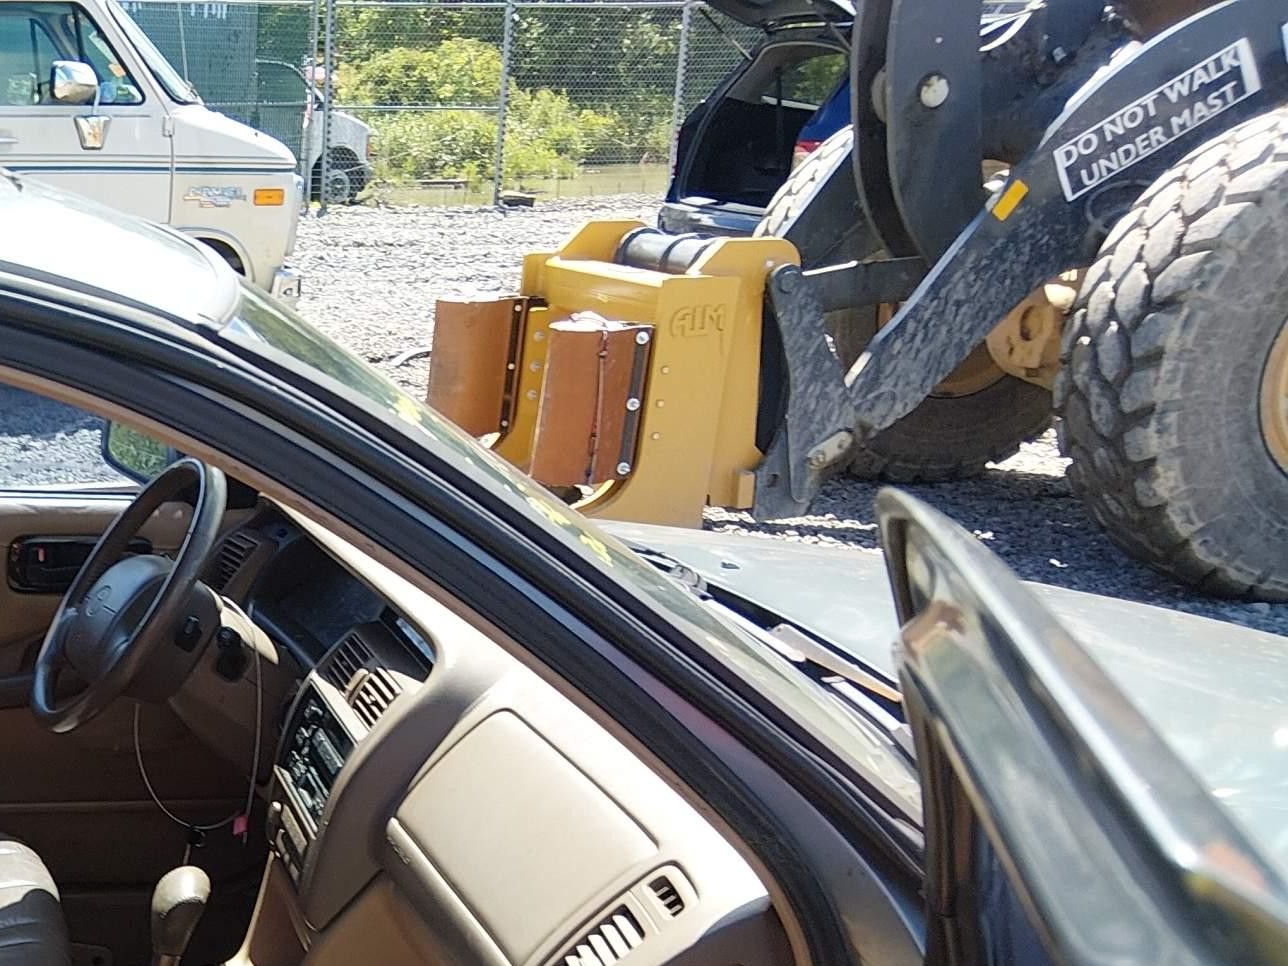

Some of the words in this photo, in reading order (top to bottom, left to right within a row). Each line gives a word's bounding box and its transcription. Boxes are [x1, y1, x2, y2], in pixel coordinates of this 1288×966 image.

[1062, 133, 1099, 169] DO
[1102, 94, 1159, 142] NOT
[1162, 45, 1242, 104] WALK
[1080, 125, 1168, 187] UNDER
[1169, 80, 1238, 136] MAST
